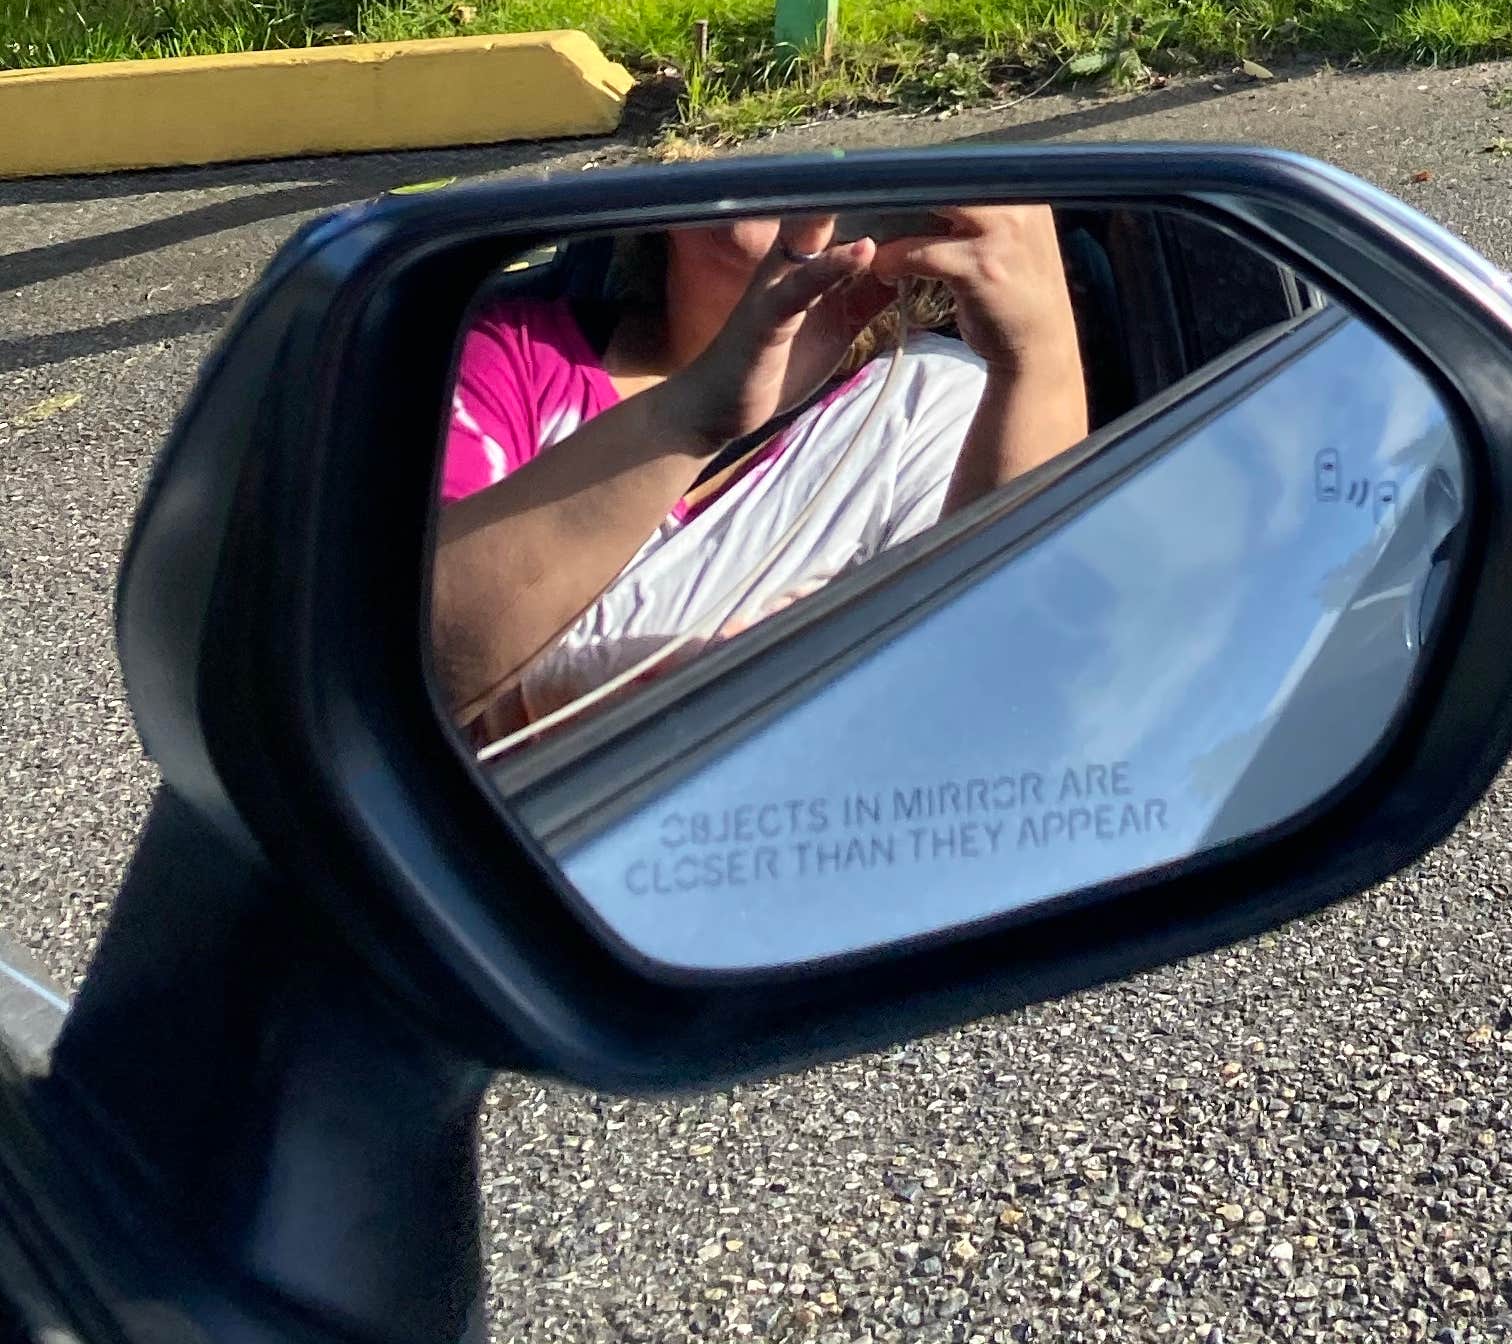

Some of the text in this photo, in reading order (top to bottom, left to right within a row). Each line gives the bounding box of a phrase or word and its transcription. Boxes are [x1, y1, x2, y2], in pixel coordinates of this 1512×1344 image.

[624, 796, 1169, 896] CLOSER THAN THEY APPEAR
[659, 760, 1135, 849] OBJECTS IN MIRROR ARE
